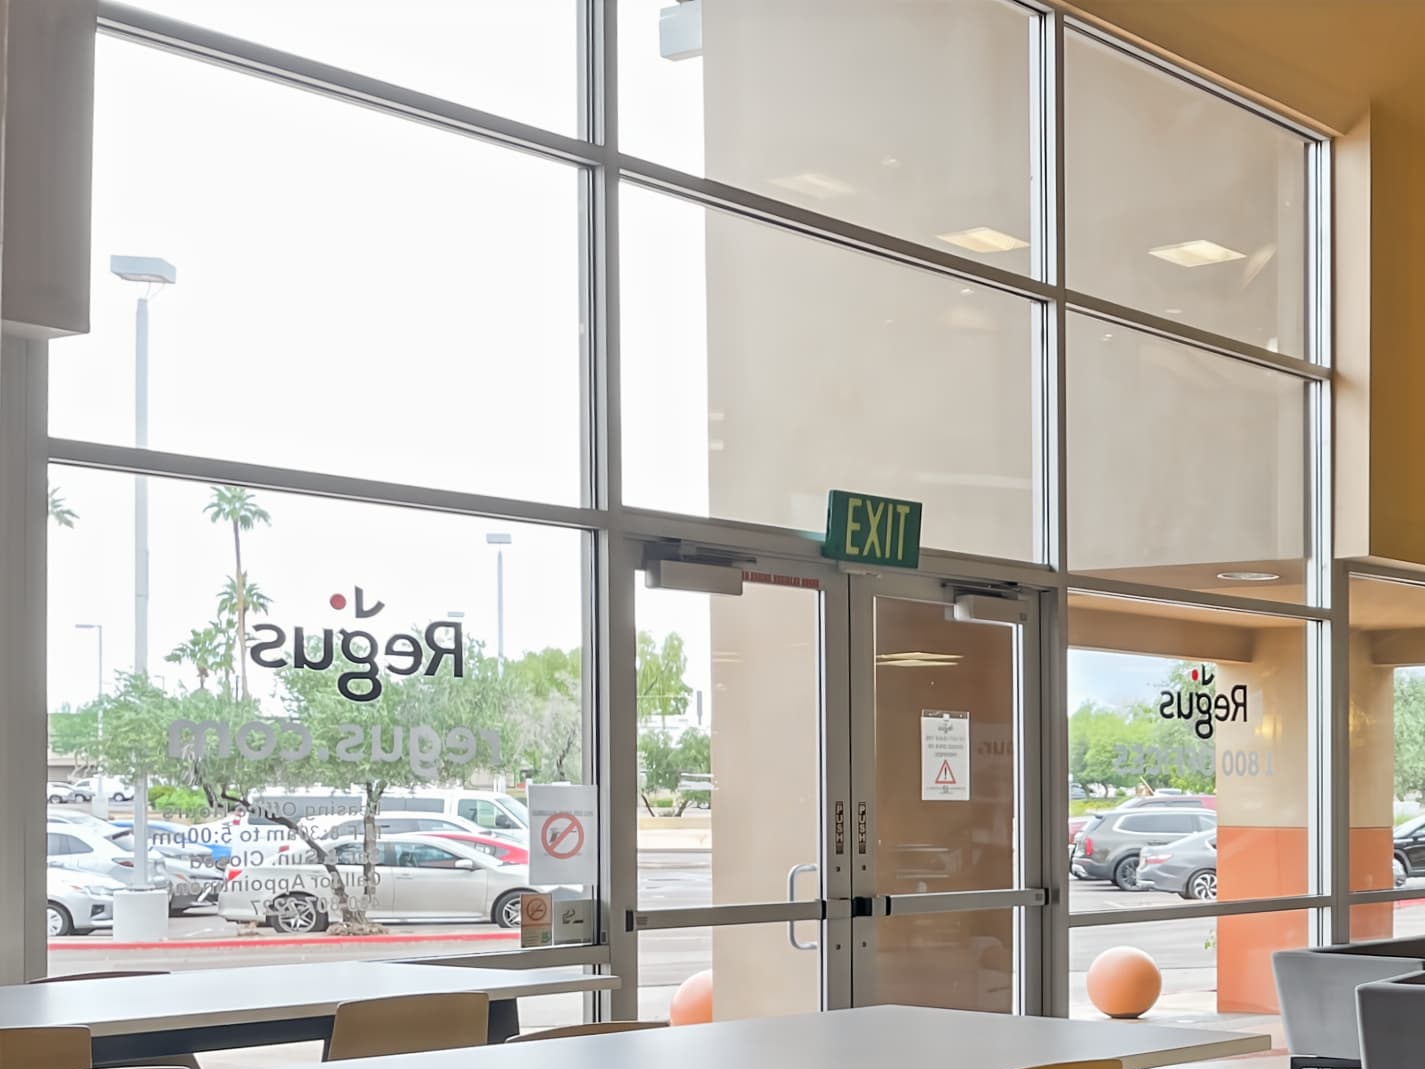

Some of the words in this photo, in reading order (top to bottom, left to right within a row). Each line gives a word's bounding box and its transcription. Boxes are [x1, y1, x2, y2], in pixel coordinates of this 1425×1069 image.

[845, 497, 910, 561] EXIT
[836, 804, 844, 843] PUSH
[859, 804, 867, 843] PUSH
